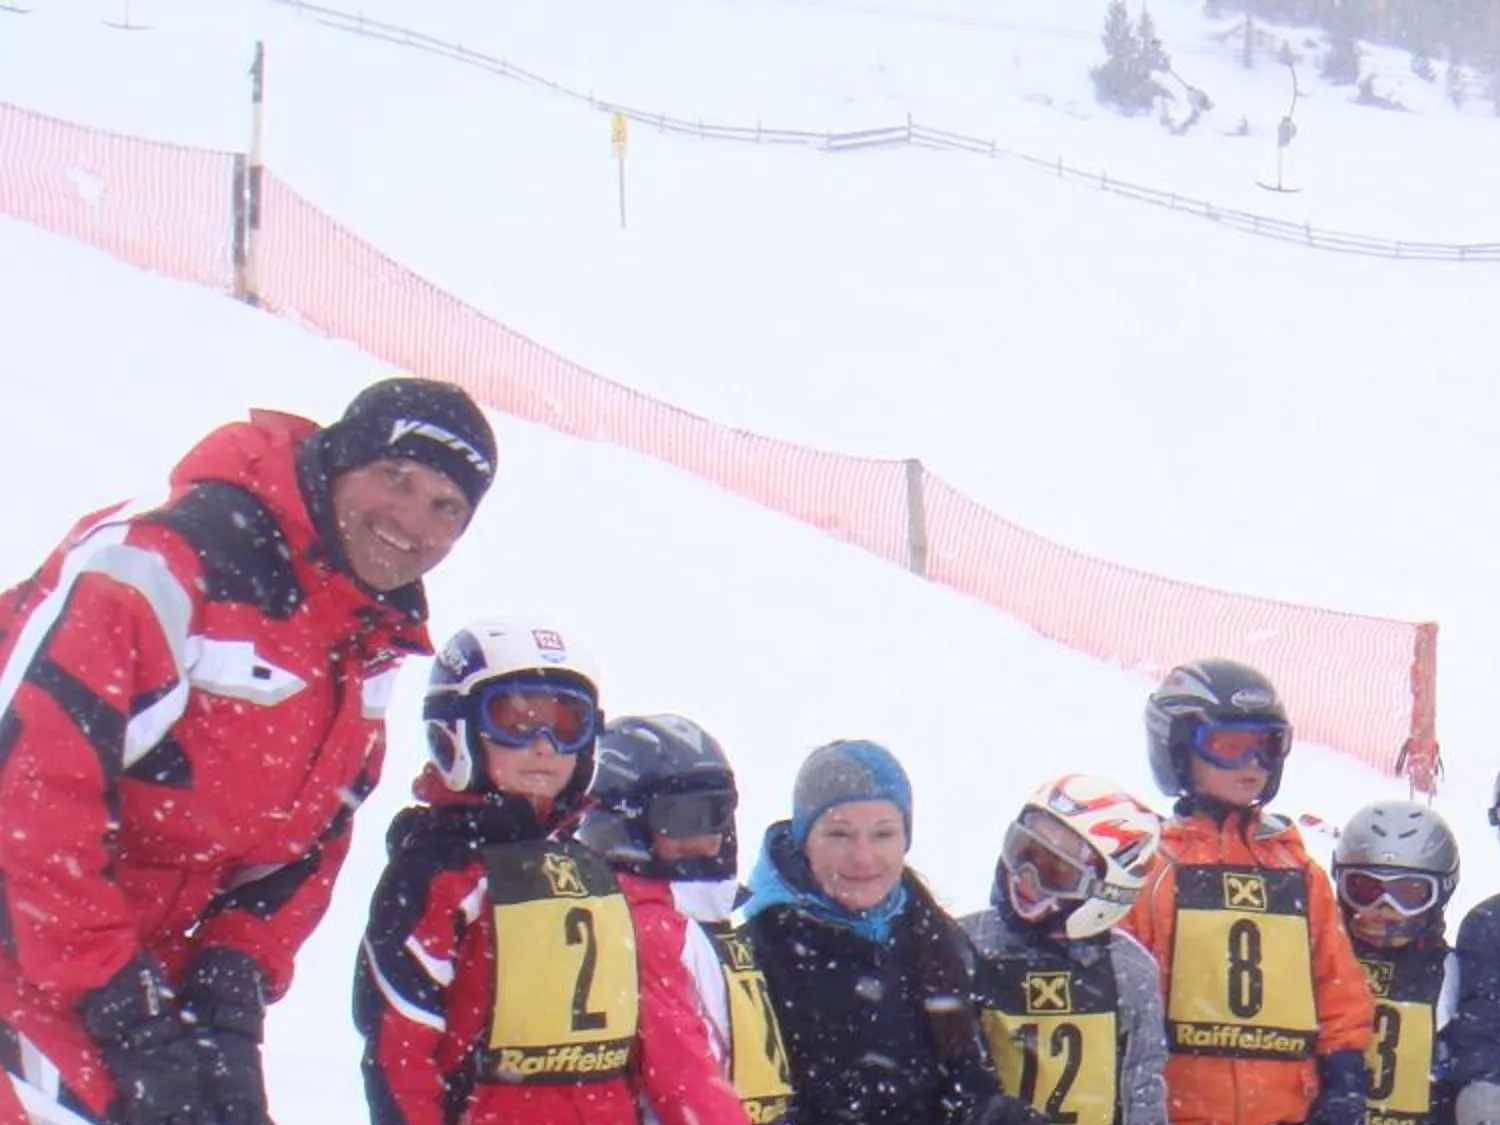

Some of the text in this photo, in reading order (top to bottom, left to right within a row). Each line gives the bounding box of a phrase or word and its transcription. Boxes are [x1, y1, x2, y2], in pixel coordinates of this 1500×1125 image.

[564, 906, 608, 1032] 2
[1228, 918, 1263, 1019] 8
[1012, 1022, 1083, 1125] 12
[1177, 1023, 1306, 1052] Raiffeisen
[1365, 1004, 1402, 1100] 3
